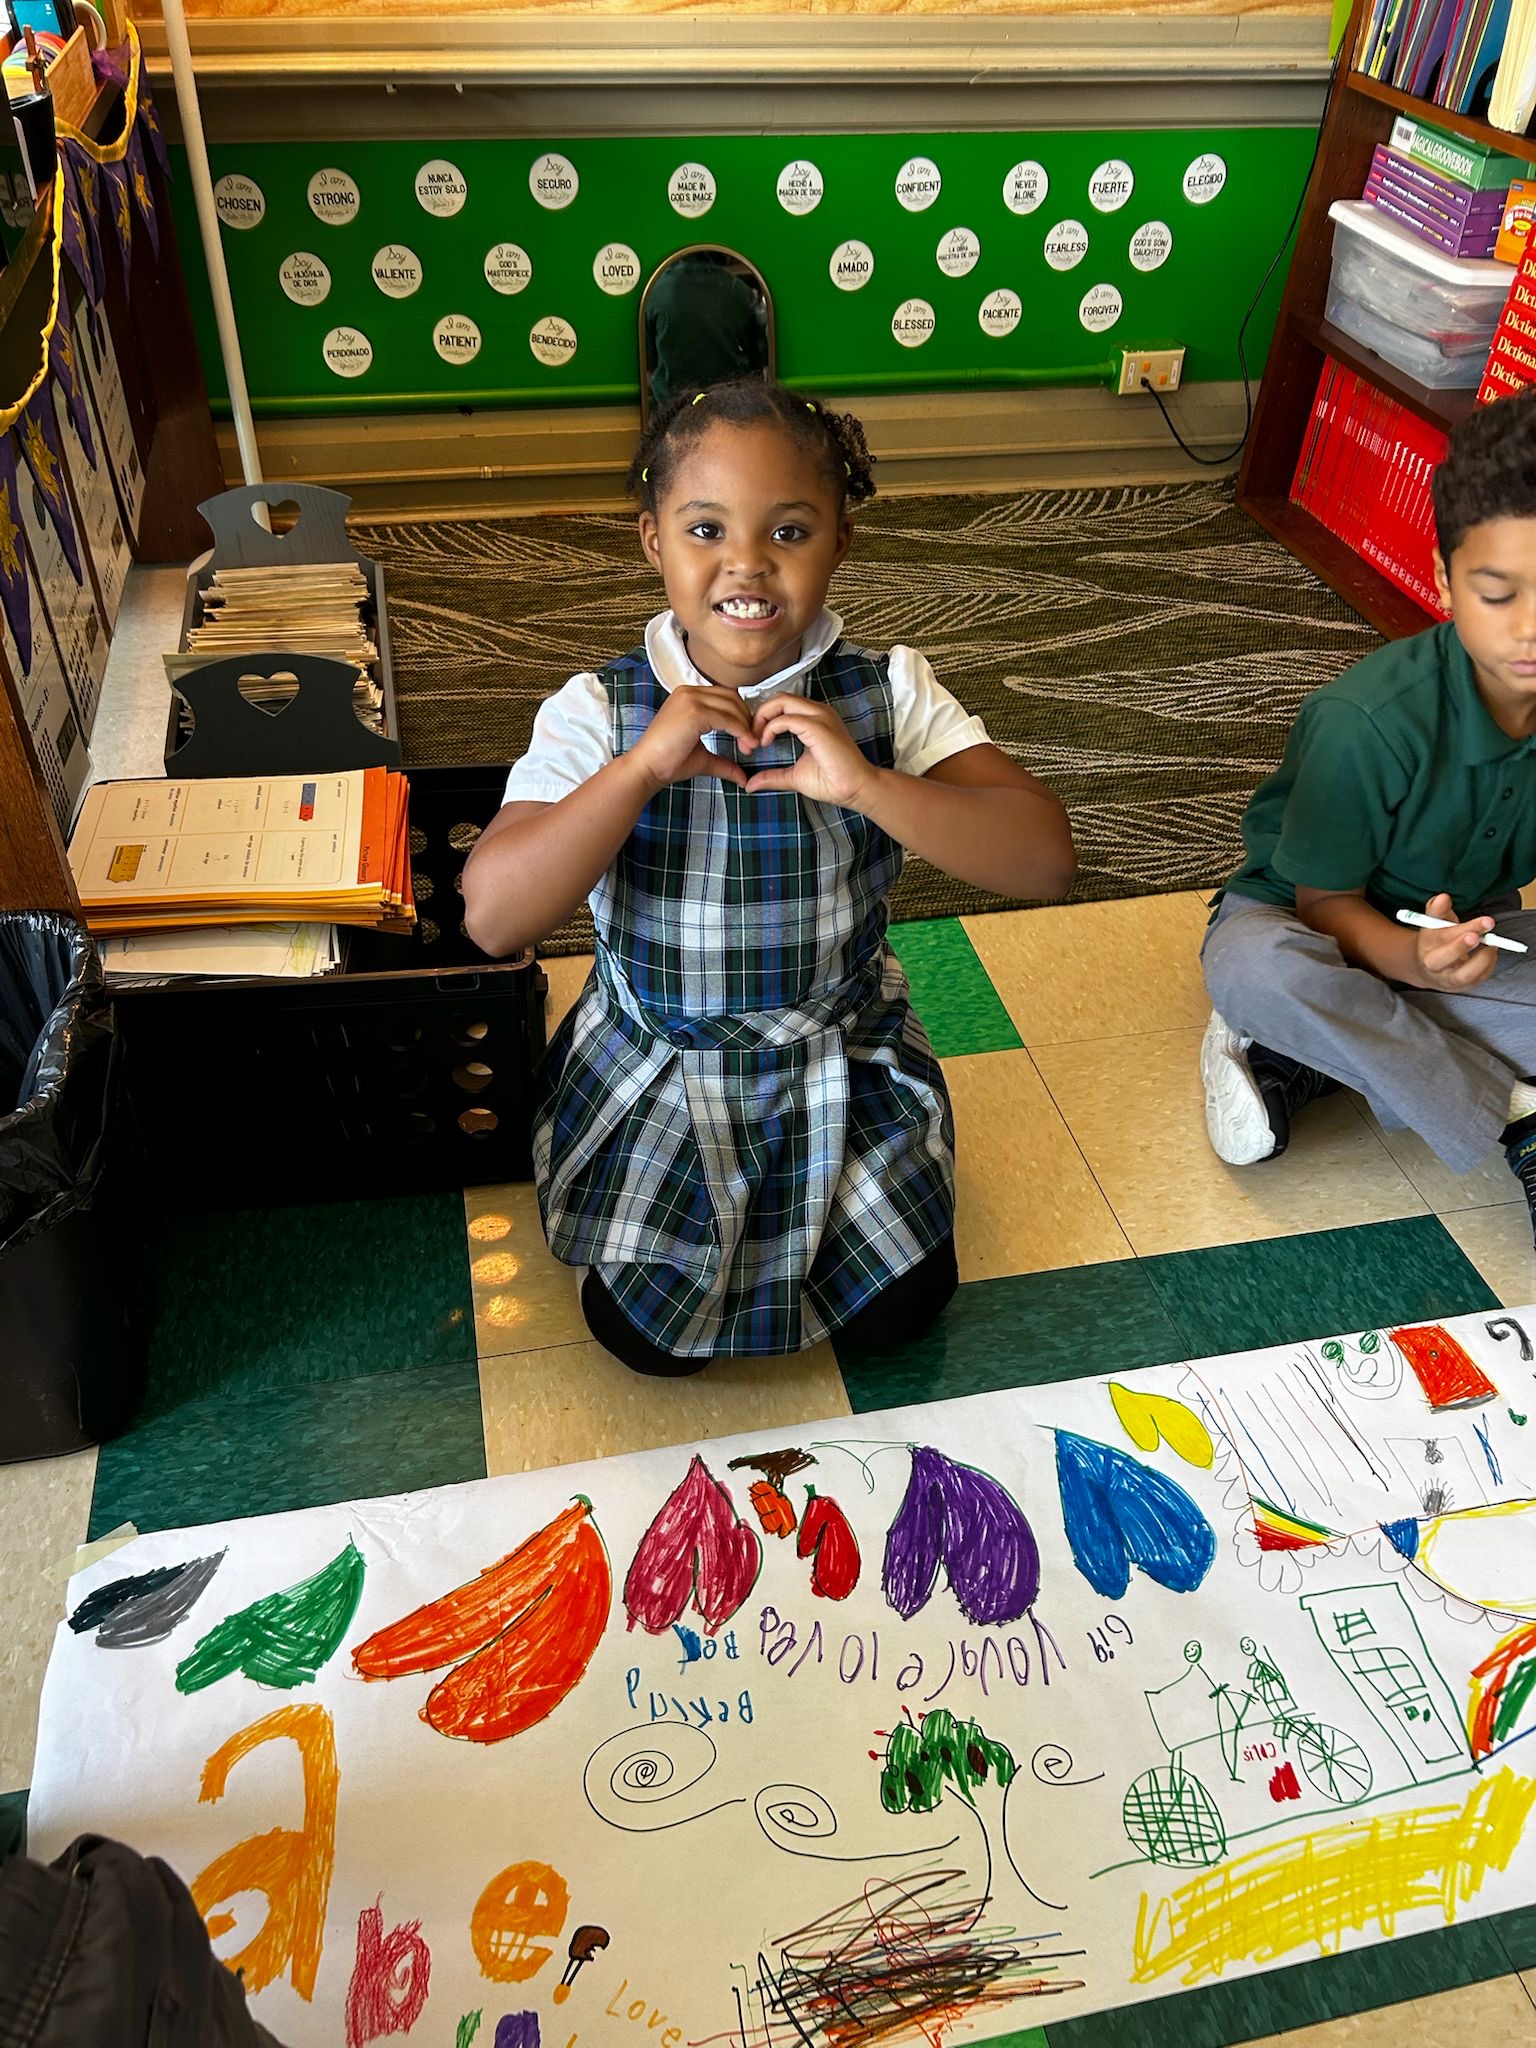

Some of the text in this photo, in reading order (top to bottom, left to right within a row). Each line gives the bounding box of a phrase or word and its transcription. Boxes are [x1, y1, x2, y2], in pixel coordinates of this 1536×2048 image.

[544, 157, 564, 176] Soy
[1104, 162, 1123, 179] Soy
[1197, 157, 1216, 172] Soy
[428, 173, 453, 183] NUNCA
[791, 163, 811, 181] Soy
[537, 179, 572, 190] SEGURO
[1014, 180, 1037, 189] NEVER
[1187, 173, 1223, 187] ELEGIDO
[419, 184, 466, 195] ESTOY SOLO
[678, 182, 706, 191] MADE IN
[810, 188, 822, 196] DIOS
[896, 180, 940, 194] CONFIDENT
[1092, 182, 1129, 194] FUERTE
[313, 192, 355, 205] STRONG
[692, 192, 713, 202] IMAGE
[1014, 191, 1036, 200] ALONE
[217, 197, 261, 212] CHOSEN
[949, 231, 968, 245] Soy
[843, 244, 862, 260] Soy
[1046, 242, 1087, 253] FEARLESS
[1134, 248, 1165, 257] DAUGHTER
[386, 247, 407, 264] Soy
[292, 255, 313, 270] Soy
[837, 261, 869, 273] AMADO
[374, 268, 416, 279] VALIENTE
[487, 269, 530, 278] MASTERPIECE
[602, 265, 634, 277] LOVED
[303, 279, 318, 287] DIOS
[994, 292, 1012, 306] Soy
[982, 308, 1020, 319] PACIENTE
[1083, 304, 1120, 316] FORGIVEN
[545, 319, 565, 335] Soy
[893, 319, 934, 330] BLESSED
[336, 330, 356, 345] Soy
[439, 334, 478, 348] PATIENT
[531, 334, 576, 349] BENDECIDO
[327, 348, 370, 358] PERDONADO
